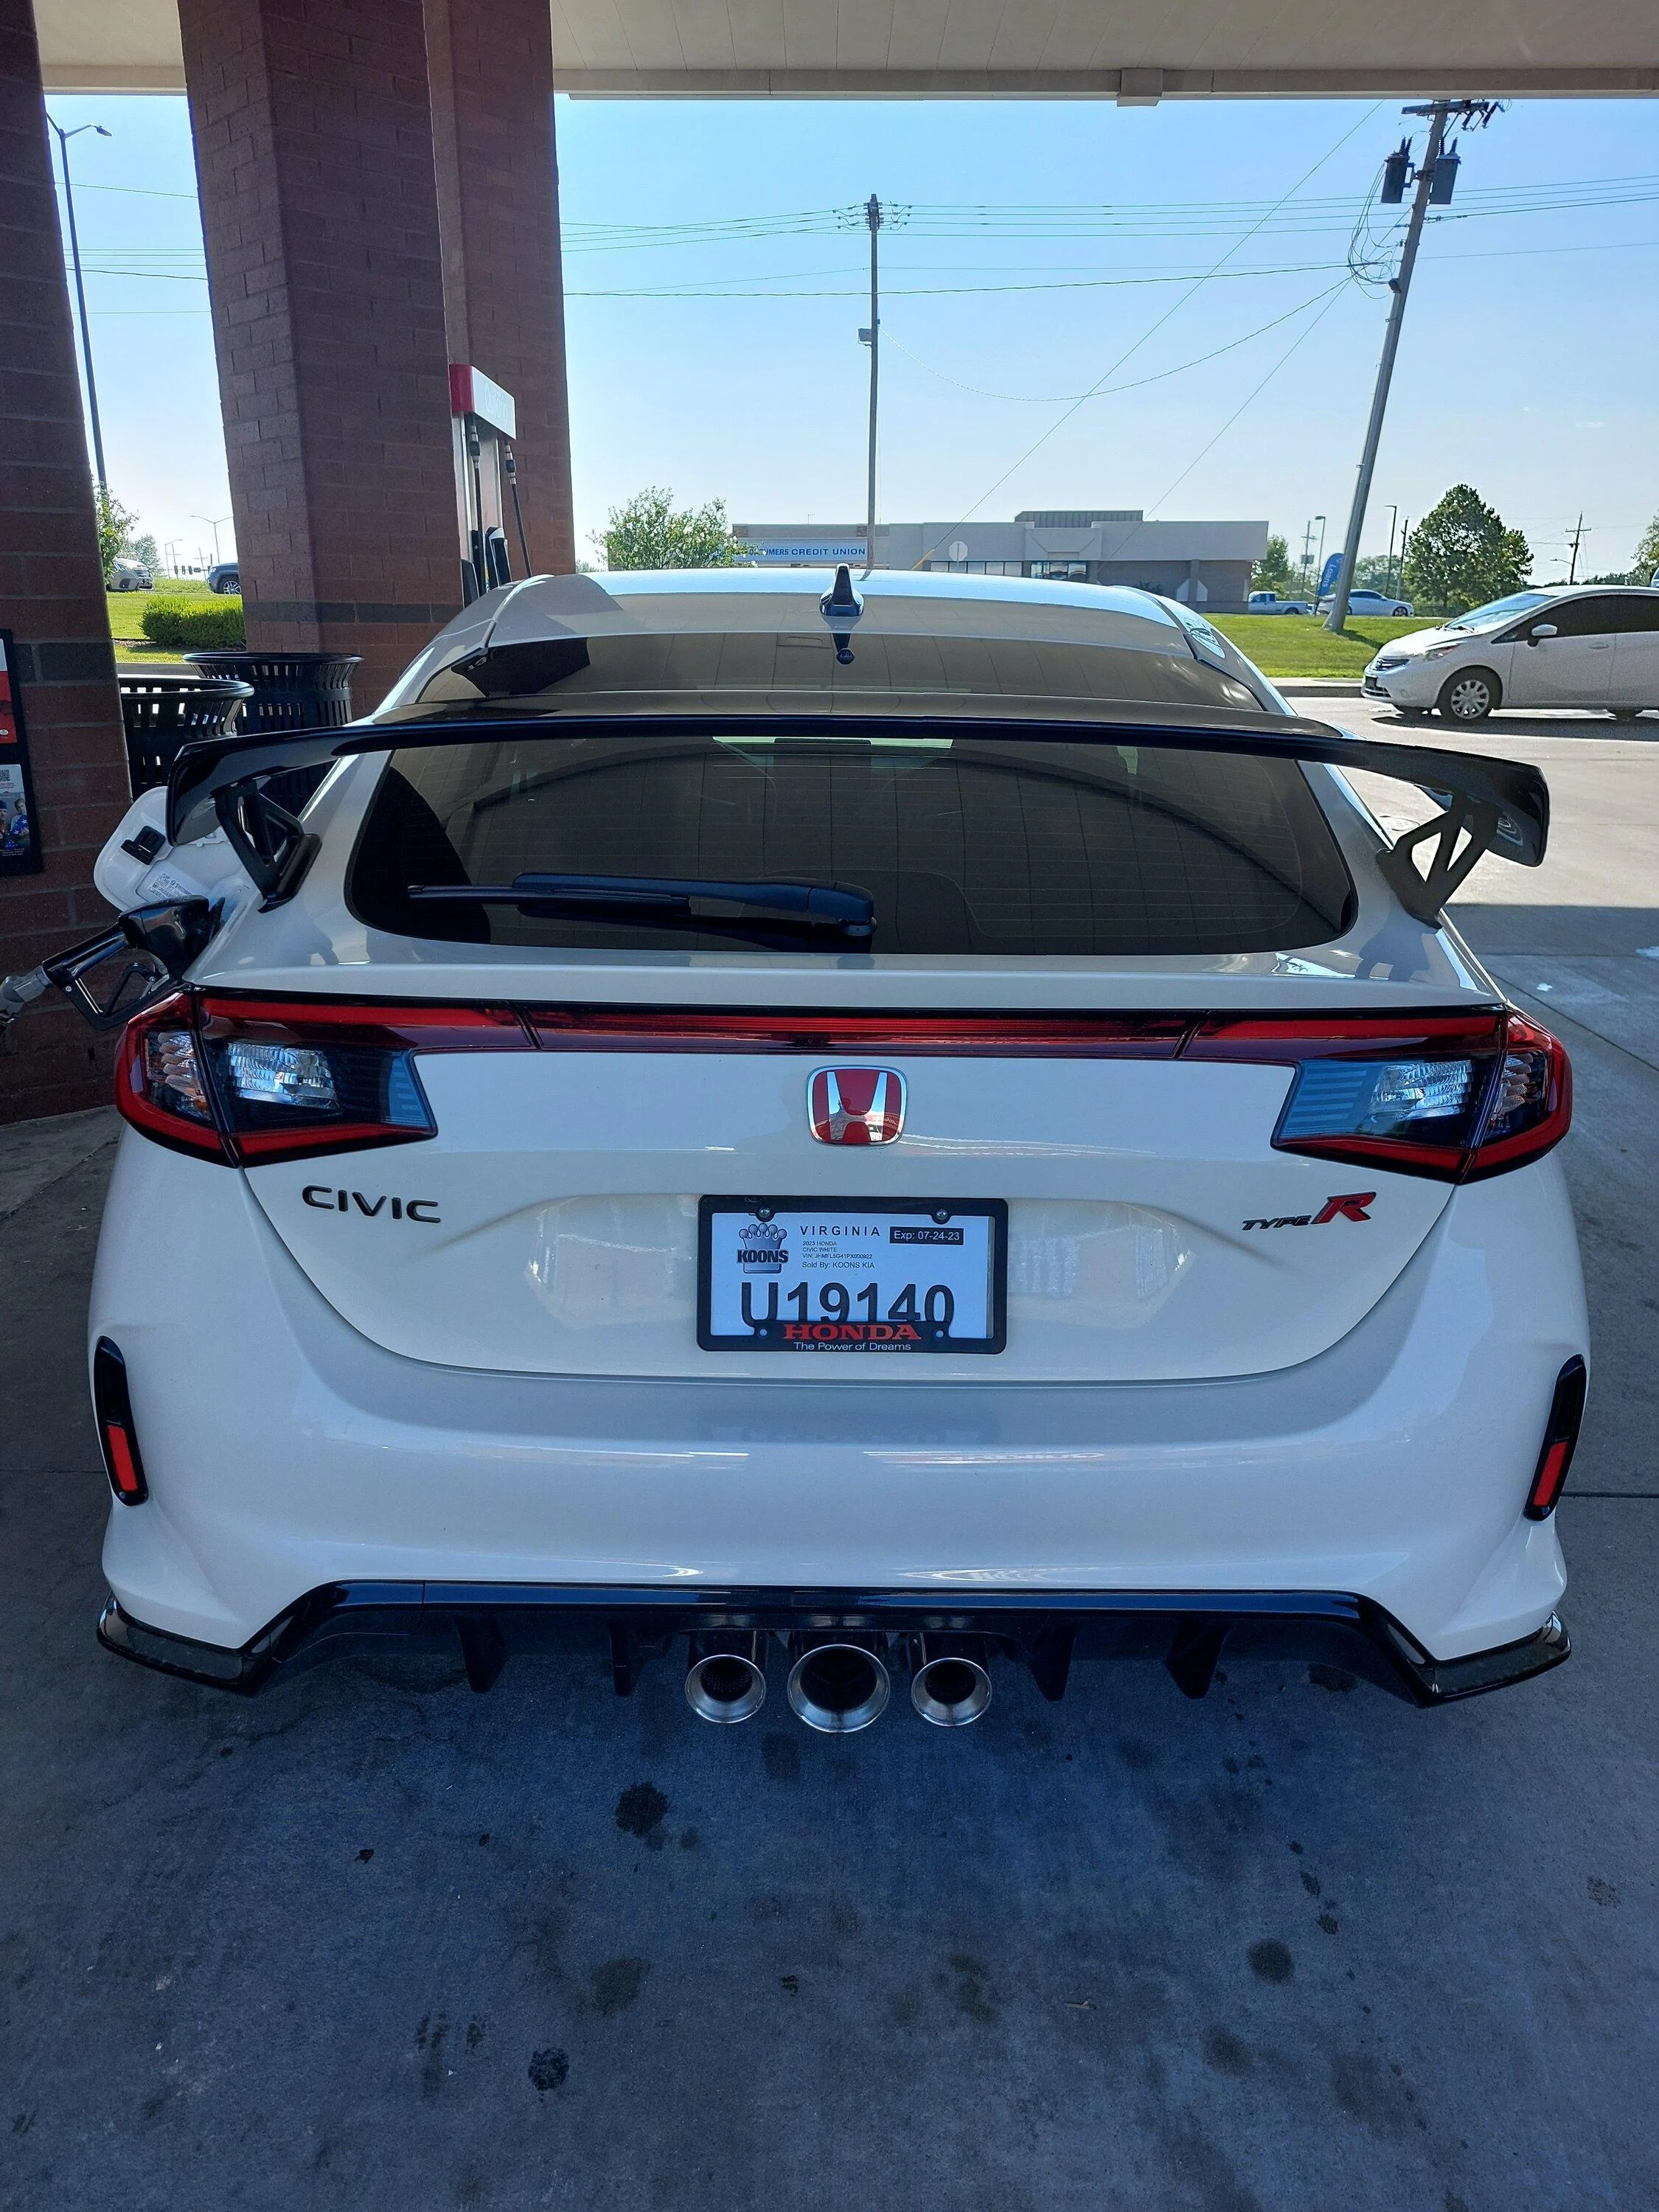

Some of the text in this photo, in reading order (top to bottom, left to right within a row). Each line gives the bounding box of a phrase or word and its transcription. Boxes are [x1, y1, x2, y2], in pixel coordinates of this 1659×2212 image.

[170, 880, 179, 888] 91
[302, 1185, 441, 1223] CIVIC
[1242, 1192, 1377, 1231] TYPE R
[799, 1225, 880, 1237] VIRGINIA
[894, 1230, 960, 1242] Exp: 07-24-23
[737, 1250, 788, 1263] KOONS
[819, 1262, 831, 1270] By:
[741, 1281, 955, 1327] U19140
[783, 1324, 922, 1340] HONDA
[793, 1342, 911, 1351] The Power of Dreams
